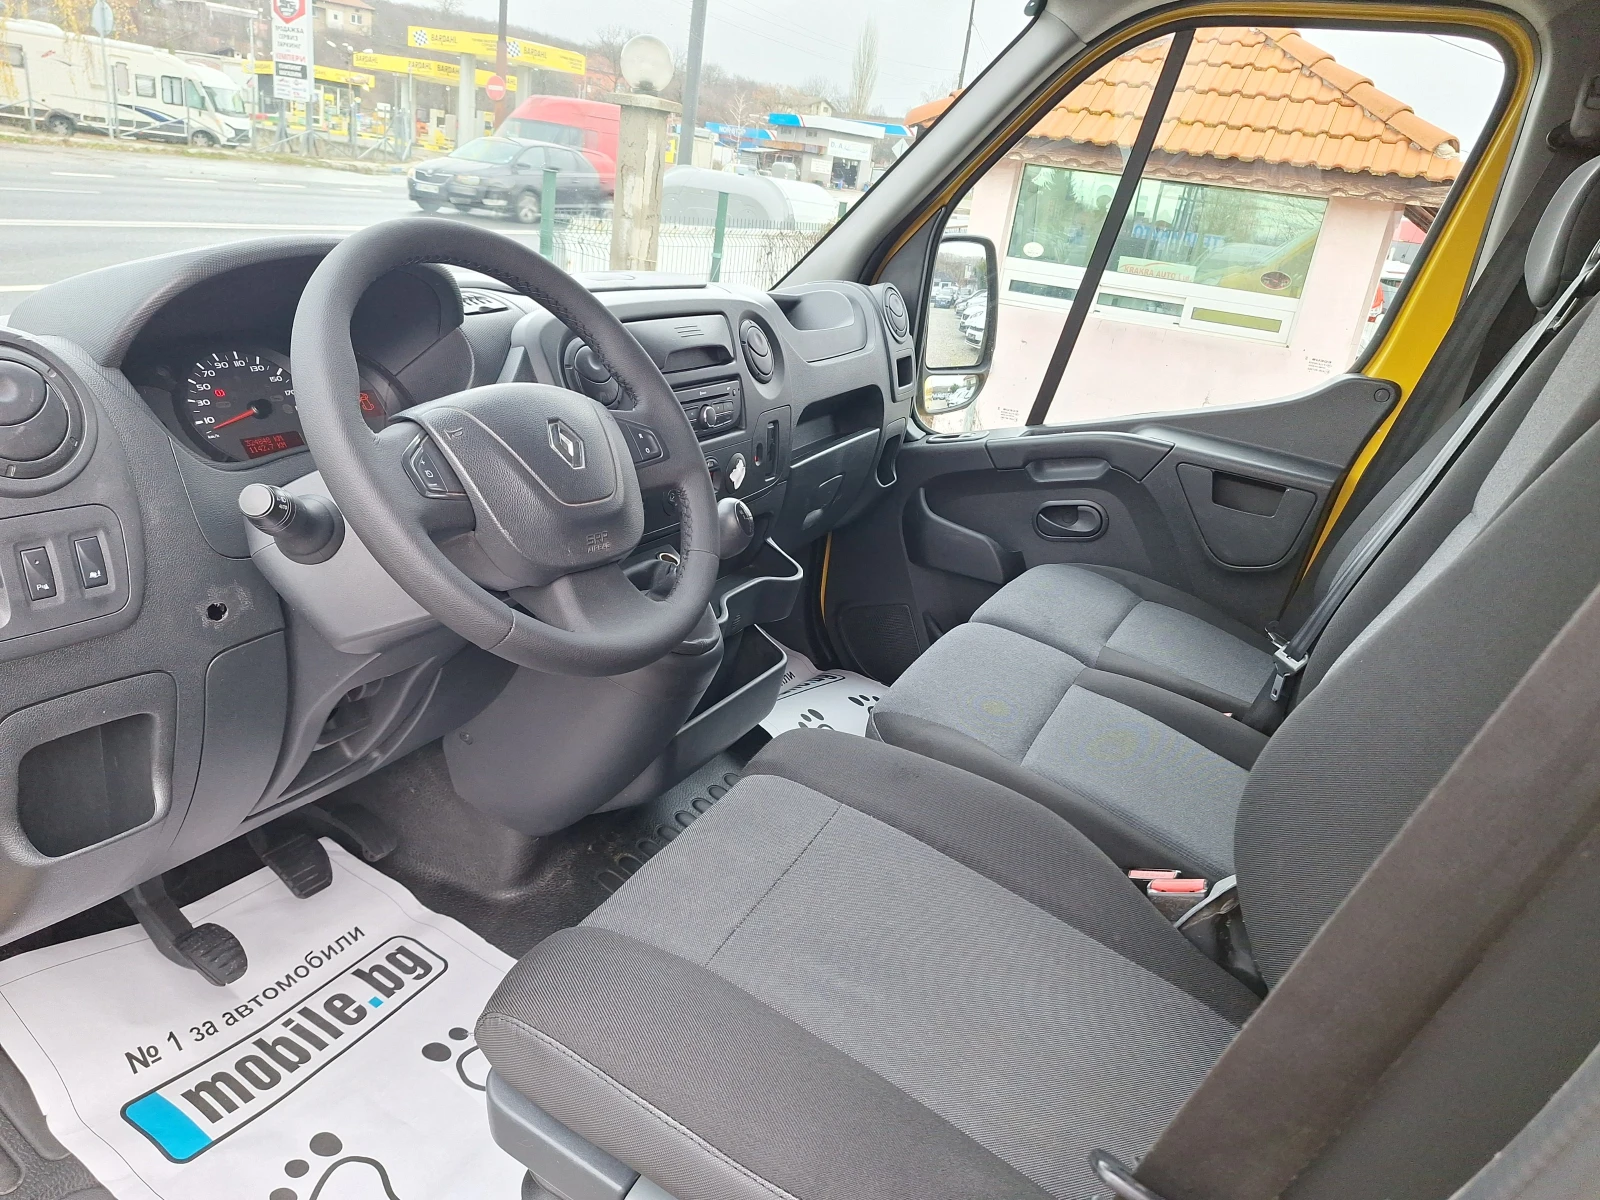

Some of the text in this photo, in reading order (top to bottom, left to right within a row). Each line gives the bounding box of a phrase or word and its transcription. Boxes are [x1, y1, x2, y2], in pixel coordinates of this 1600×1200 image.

[431, 33, 458, 44] BARDAHL
[523, 46, 547, 59] BARDAHL
[1123, 266, 1154, 276] KRAKRA
[1156, 269, 1176, 279] AUTO
[214, 361, 229, 369] 90
[196, 383, 211, 391] 50
[197, 399, 211, 407] 30
[204, 416, 216, 424] 10
[166, 1031, 184, 1052] 1
[189, 1019, 219, 1043] за
[222, 926, 366, 1027] автомобили
[180, 945, 433, 1124] mobile.bg
